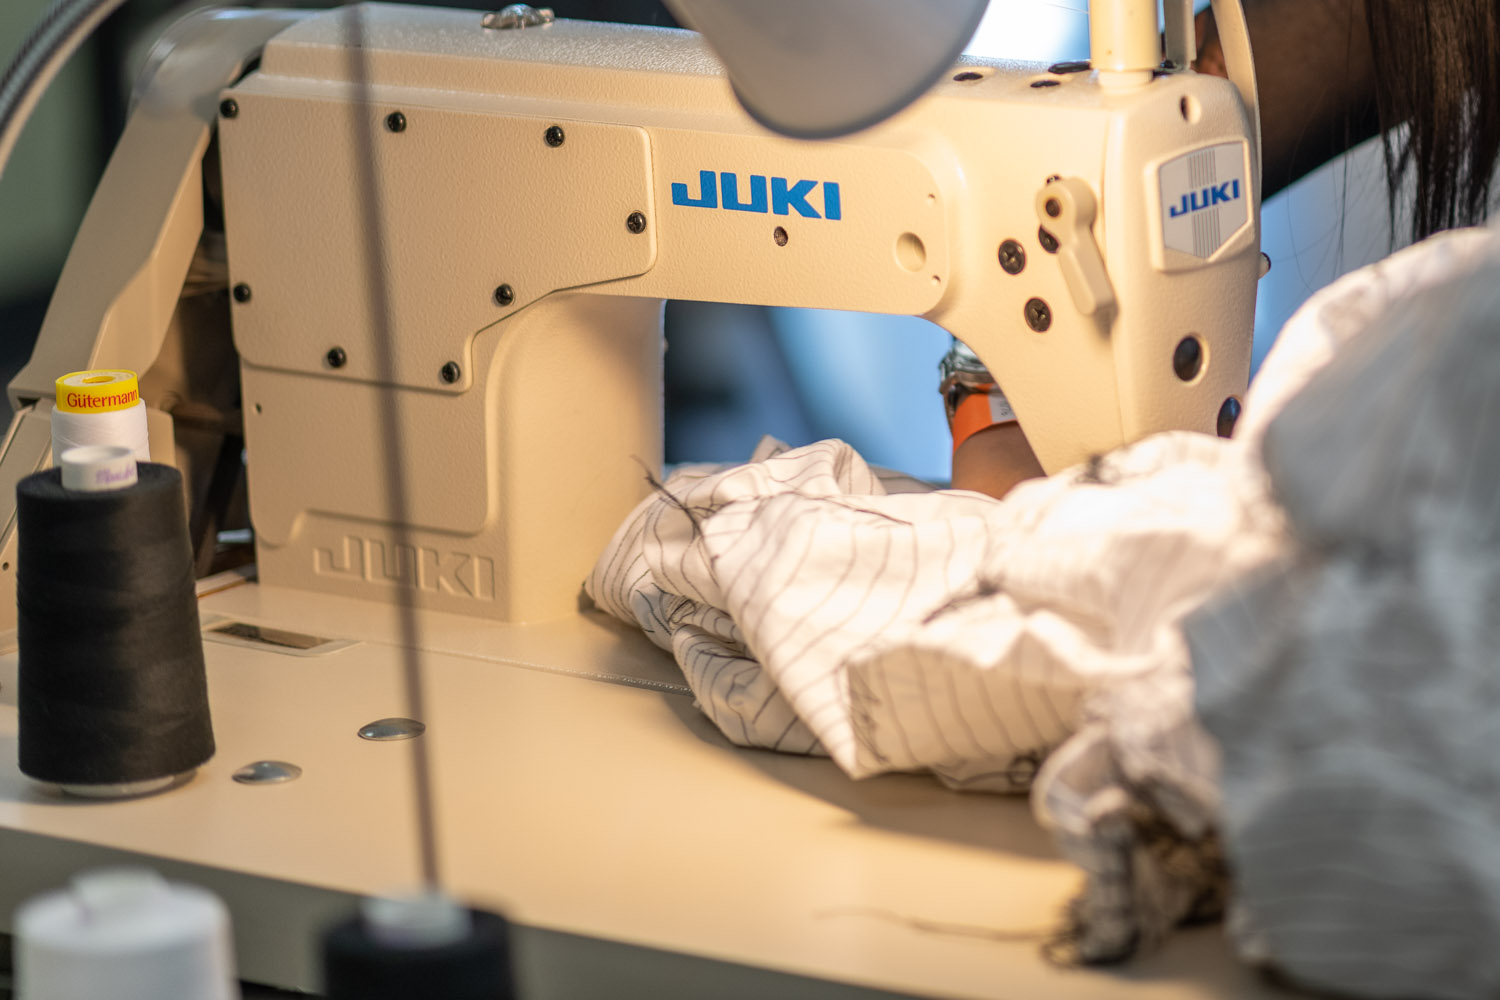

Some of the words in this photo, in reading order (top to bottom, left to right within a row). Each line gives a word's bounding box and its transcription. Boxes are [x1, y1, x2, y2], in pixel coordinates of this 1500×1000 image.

[671, 170, 841, 221] JUKI
[1169, 179, 1240, 218] JUKI
[66, 389, 138, 409] Gütermann
[312, 535, 496, 602] JUKI
